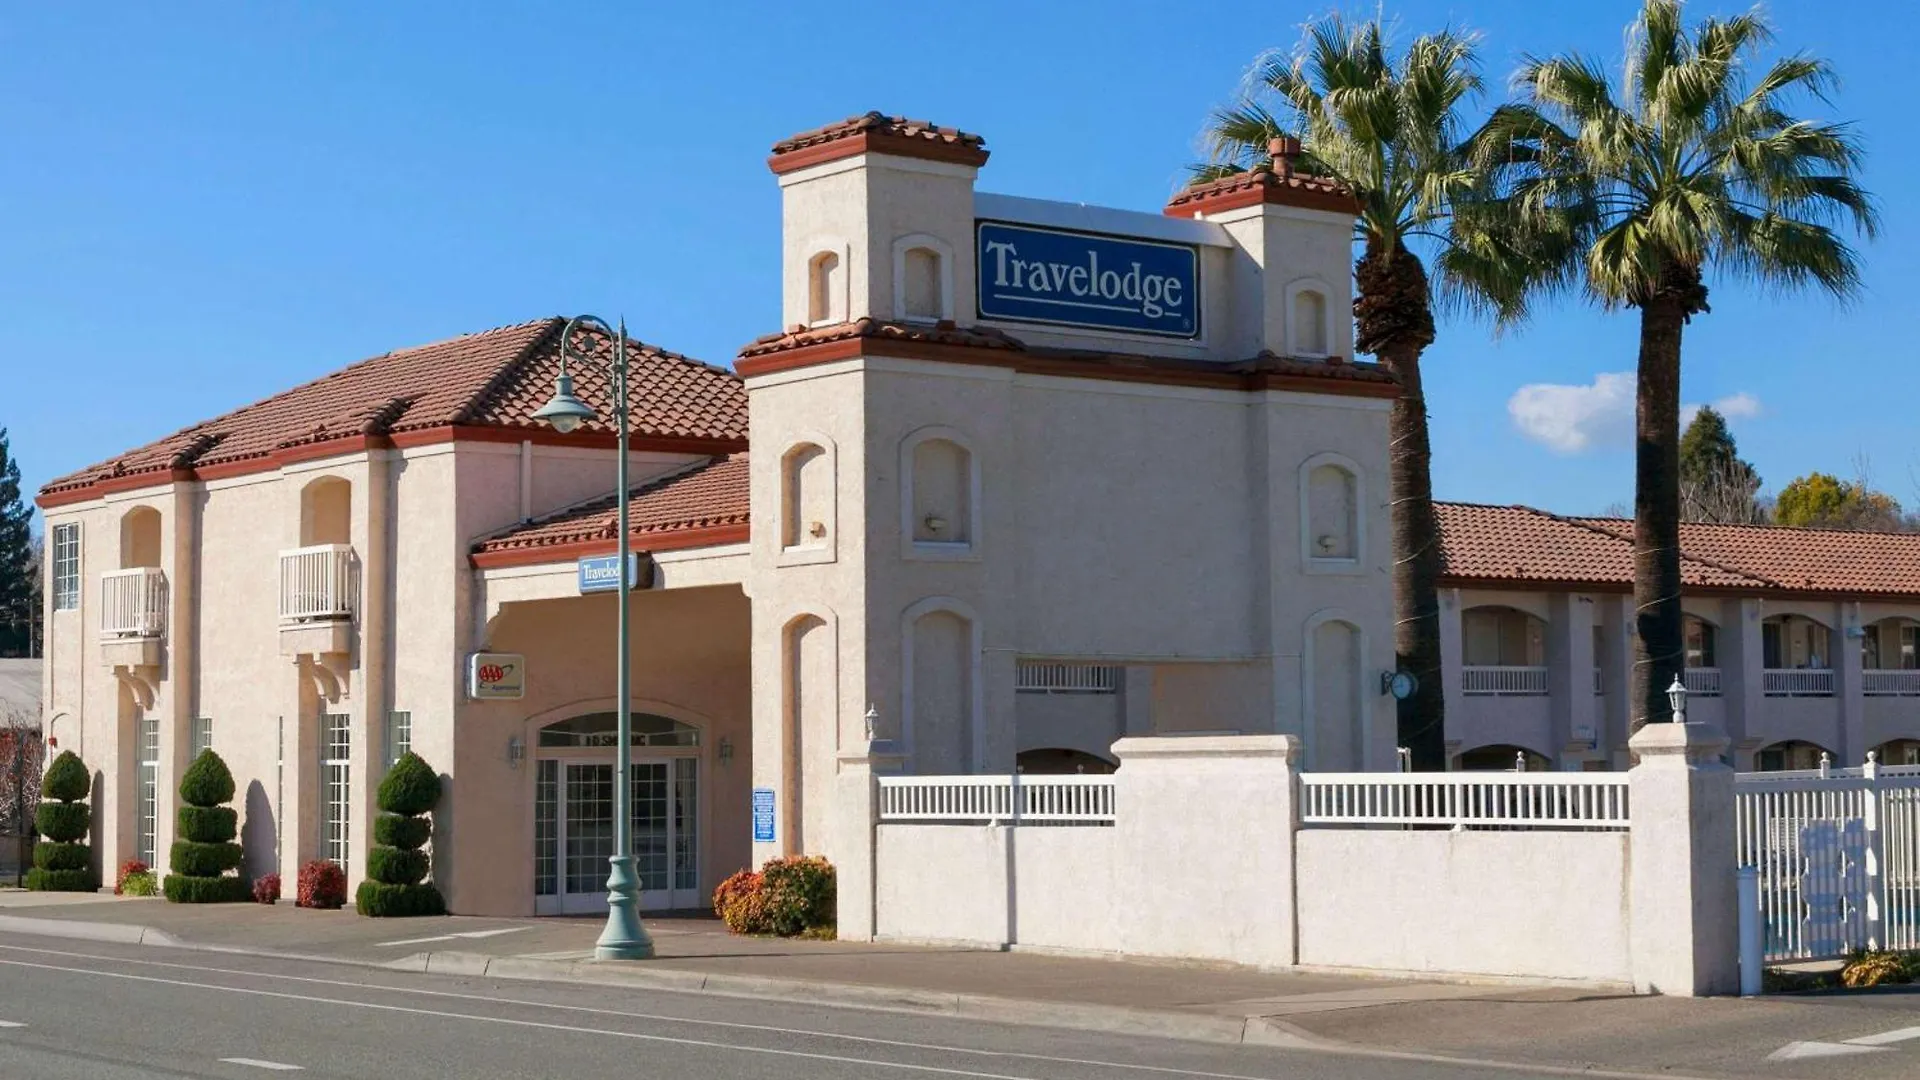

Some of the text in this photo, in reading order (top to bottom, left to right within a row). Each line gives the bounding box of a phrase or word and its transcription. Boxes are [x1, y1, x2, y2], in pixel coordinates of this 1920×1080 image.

[986, 240, 1182, 318] Travelodge
[583, 561, 622, 580] Travelod
[480, 665, 502, 681] AAA
